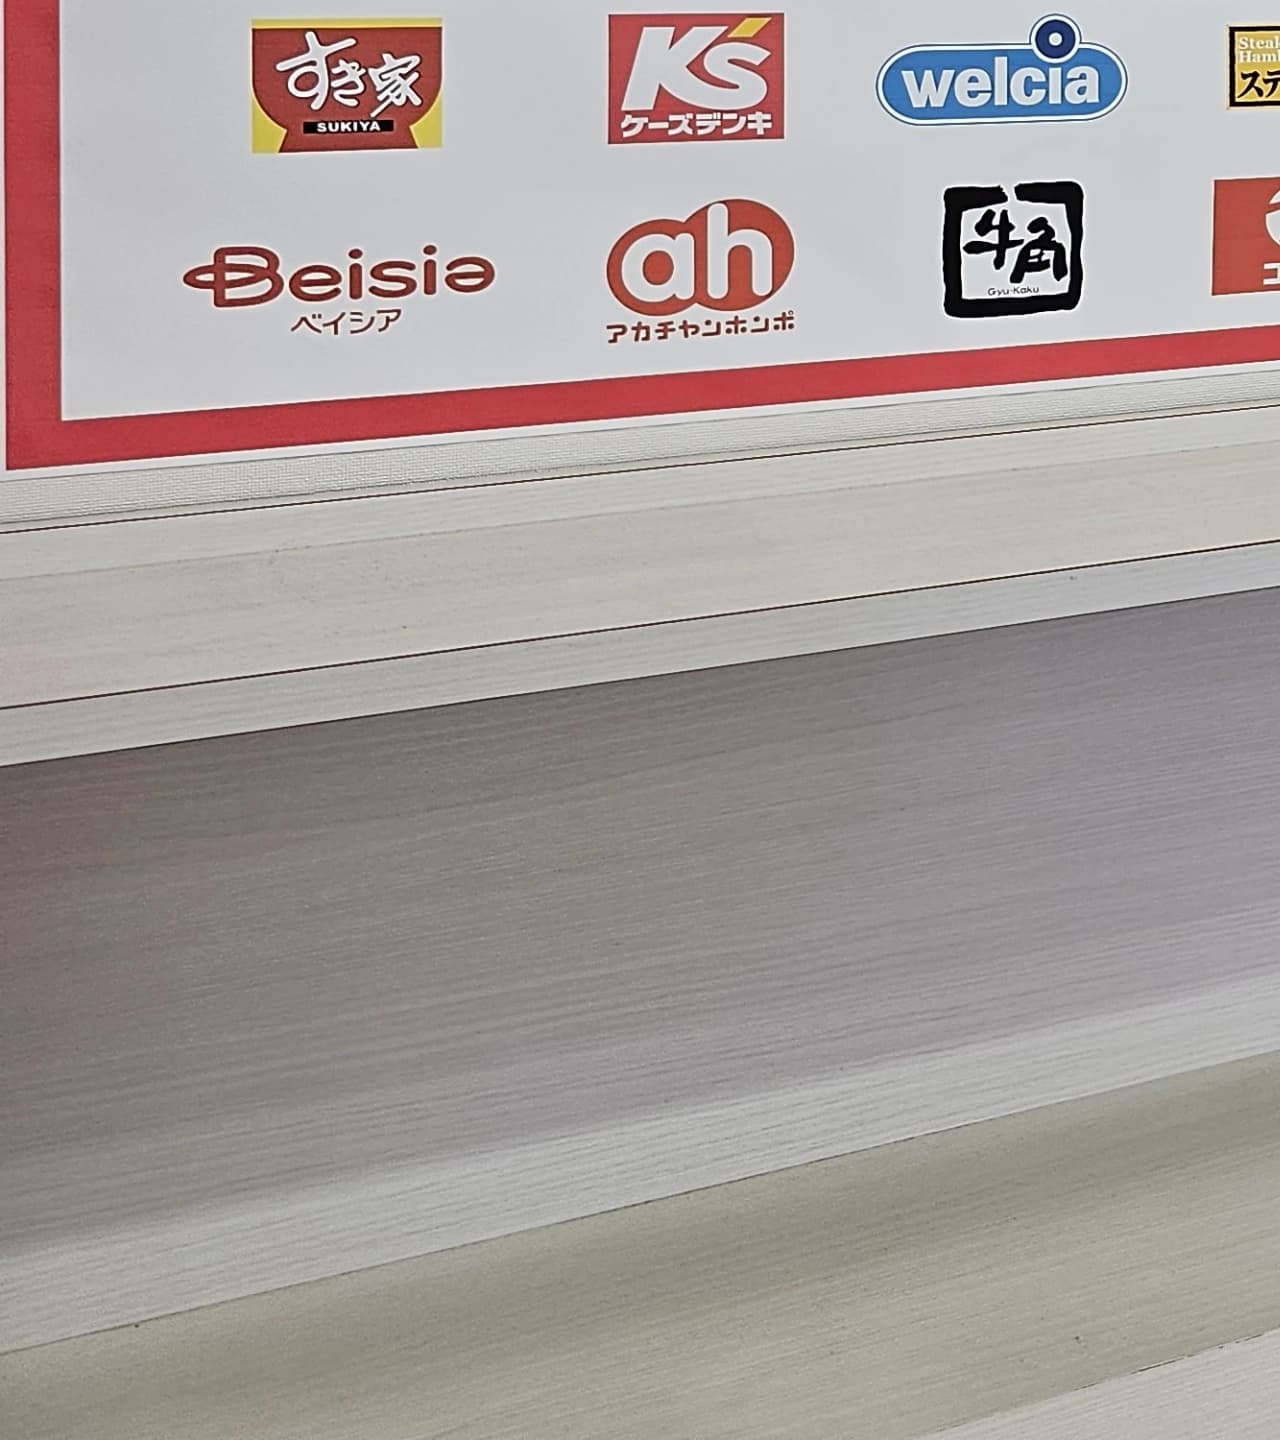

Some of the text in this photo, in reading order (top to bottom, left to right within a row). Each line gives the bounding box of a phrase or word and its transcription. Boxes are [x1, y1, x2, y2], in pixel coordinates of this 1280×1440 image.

[275, 30, 423, 118] すき家
[900, 58, 1100, 109] welcia
[315, 119, 381, 134] SUKIYA
[619, 112, 773, 139] ケーズデンキ
[960, 208, 1069, 285] 牛角
[289, 308, 404, 338] ベイシア
[605, 309, 797, 345] アカチャンホンポ
